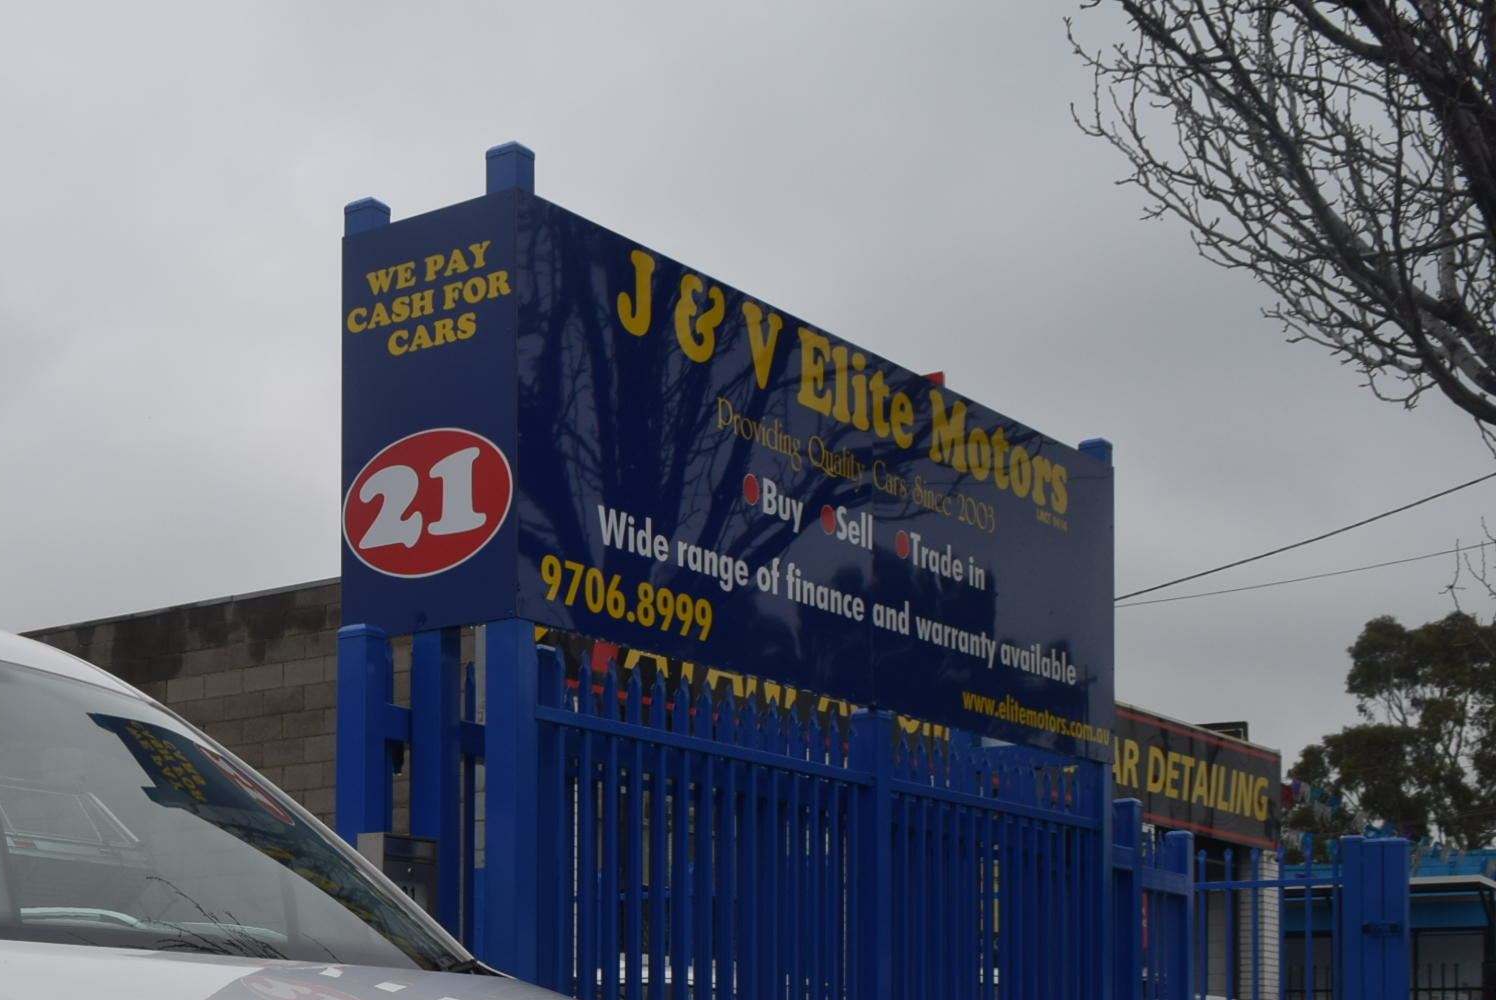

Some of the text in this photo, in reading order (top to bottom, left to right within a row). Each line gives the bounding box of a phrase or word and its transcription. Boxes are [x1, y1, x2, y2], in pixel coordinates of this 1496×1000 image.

[347, 270, 512, 333] CASH FOR
[366, 240, 491, 296] WE PAY
[387, 312, 476, 356] CARS
[617, 250, 1068, 514] J & V Elite Motors
[358, 446, 487, 549] 21
[716, 396, 996, 534] Providing Quality Cars Since 2003
[762, 477, 986, 590] Buy Sell Trade in
[540, 554, 714, 642] 9706.8999
[597, 504, 1077, 685] Wide range of finance and warranty available
[962, 690, 1111, 745] www.elitemotors.com.au
[1146, 746, 1269, 822] DETAILING
